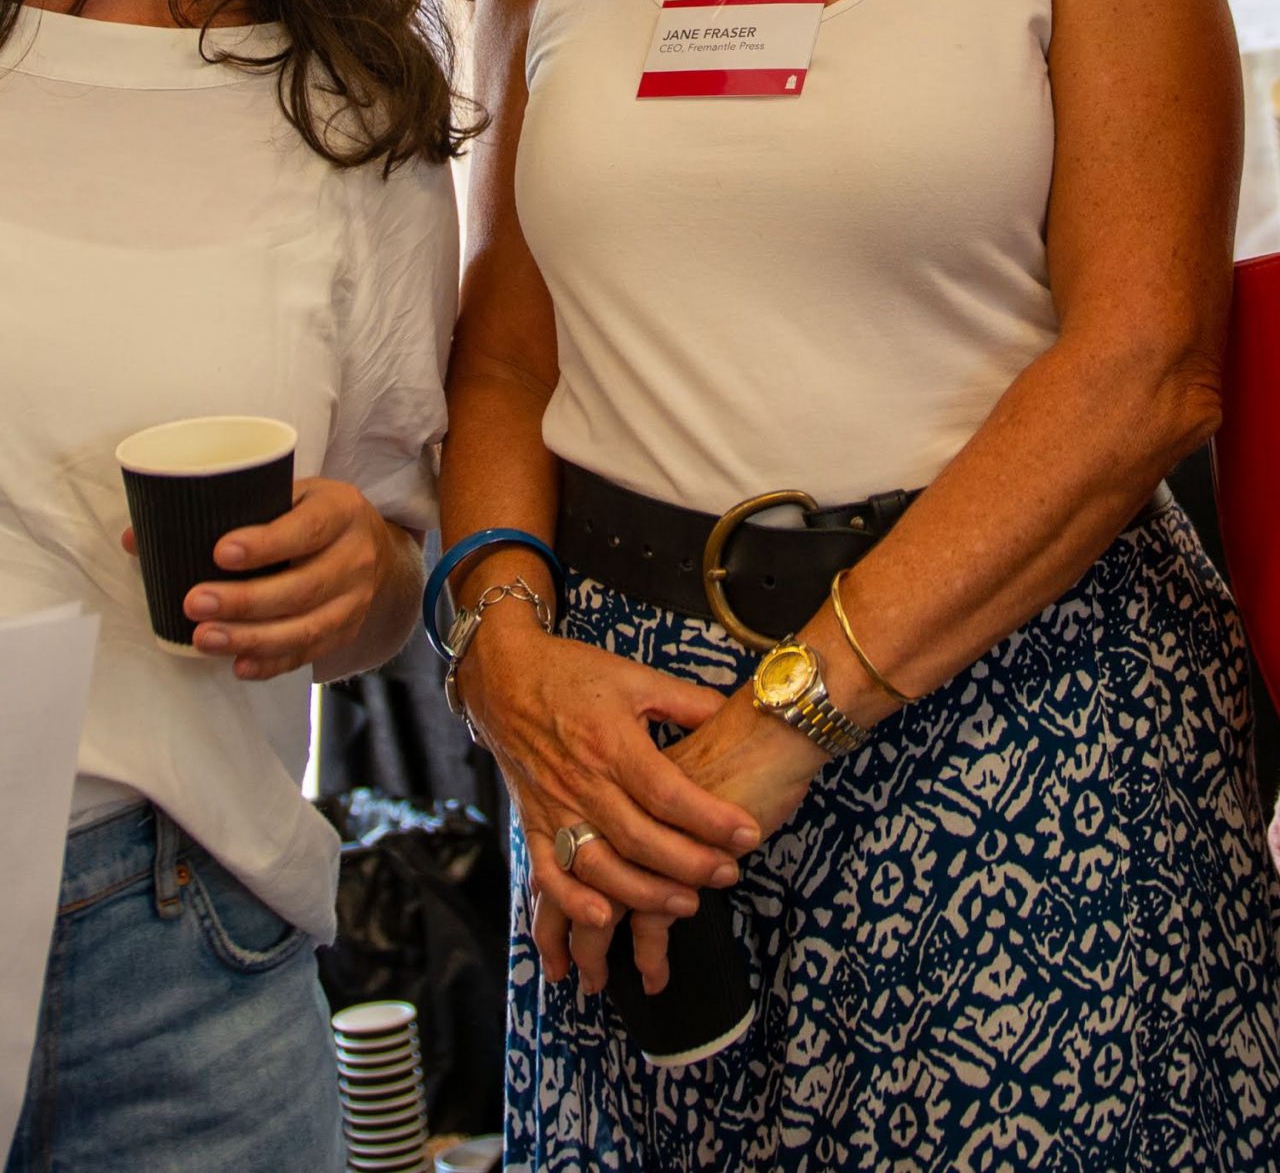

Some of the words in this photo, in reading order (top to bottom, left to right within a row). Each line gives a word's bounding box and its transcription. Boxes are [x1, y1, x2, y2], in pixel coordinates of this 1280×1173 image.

[662, 28, 700, 41] JANE
[703, 26, 757, 39] FRASER
[659, 43, 685, 54] CEO,
[687, 41, 736, 53] Fremantle
[739, 41, 765, 51] Press
